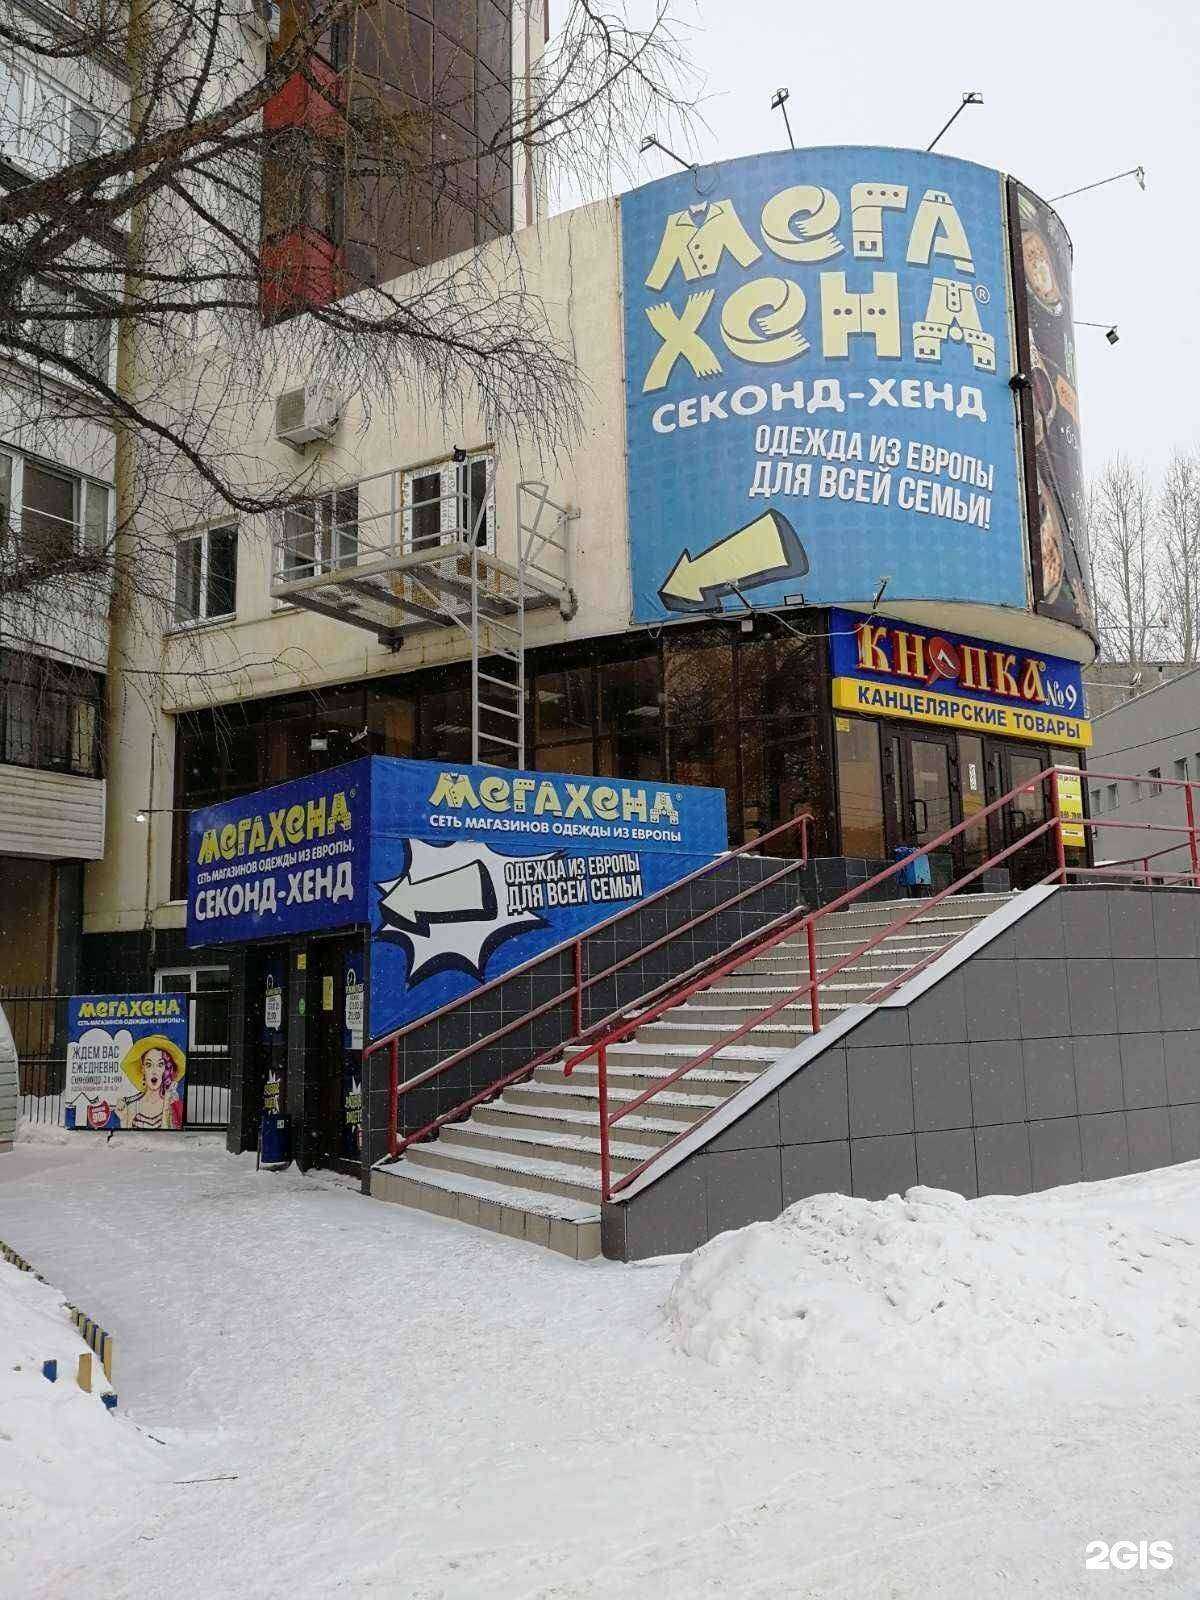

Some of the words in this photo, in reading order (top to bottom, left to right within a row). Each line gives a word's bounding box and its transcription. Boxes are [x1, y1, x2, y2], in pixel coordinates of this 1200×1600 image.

[652, 378, 988, 433] СЕКОНД-ХЕНД
[754, 424, 862, 462] ОДЕЖДА
[870, 434, 901, 467] ИЗ
[908, 442, 994, 491] ЕВРОПЫ
[749, 461, 812, 498] ДЛЯ
[819, 466, 890, 506] ВСЕЙ
[898, 479, 992, 529] СЕМЬИ!
[858, 685, 1007, 727] КАНЦЕЛЯРСКИЕ
[1013, 712, 1080, 739] ТОВАРЫ
[429, 815, 462, 828] СЕТЬ
[465, 817, 550, 833] МАГАЗИНОВ
[552, 823, 611, 838] ОДЕЖДЫ
[613, 827, 629, 839] ИЗ
[632, 828, 682, 842] ЕВРОПЫ
[212, 860, 258, 881] МАГАЗИНОВ
[258, 852, 297, 871] ОДЕЖДЫ
[298, 849, 311, 863] ИЗ
[505, 857, 566, 885] ОДЕЖДА
[568, 857, 585, 878] ИЗ
[588, 852, 640, 876] ЕВРОПЫ
[195, 861, 354, 921] СЕКОНД-ХЕНД
[507, 883, 544, 916] ДЛЯ
[548, 875, 588, 907] ВСЕЙ
[591, 873, 643, 901] СЕМЬИ
[72, 1061, 119, 1074] ЕЖЕДНЕВНО
[73, 1046, 100, 1060] ЖДЕМ
[102, 1045, 120, 1058] ВАС
